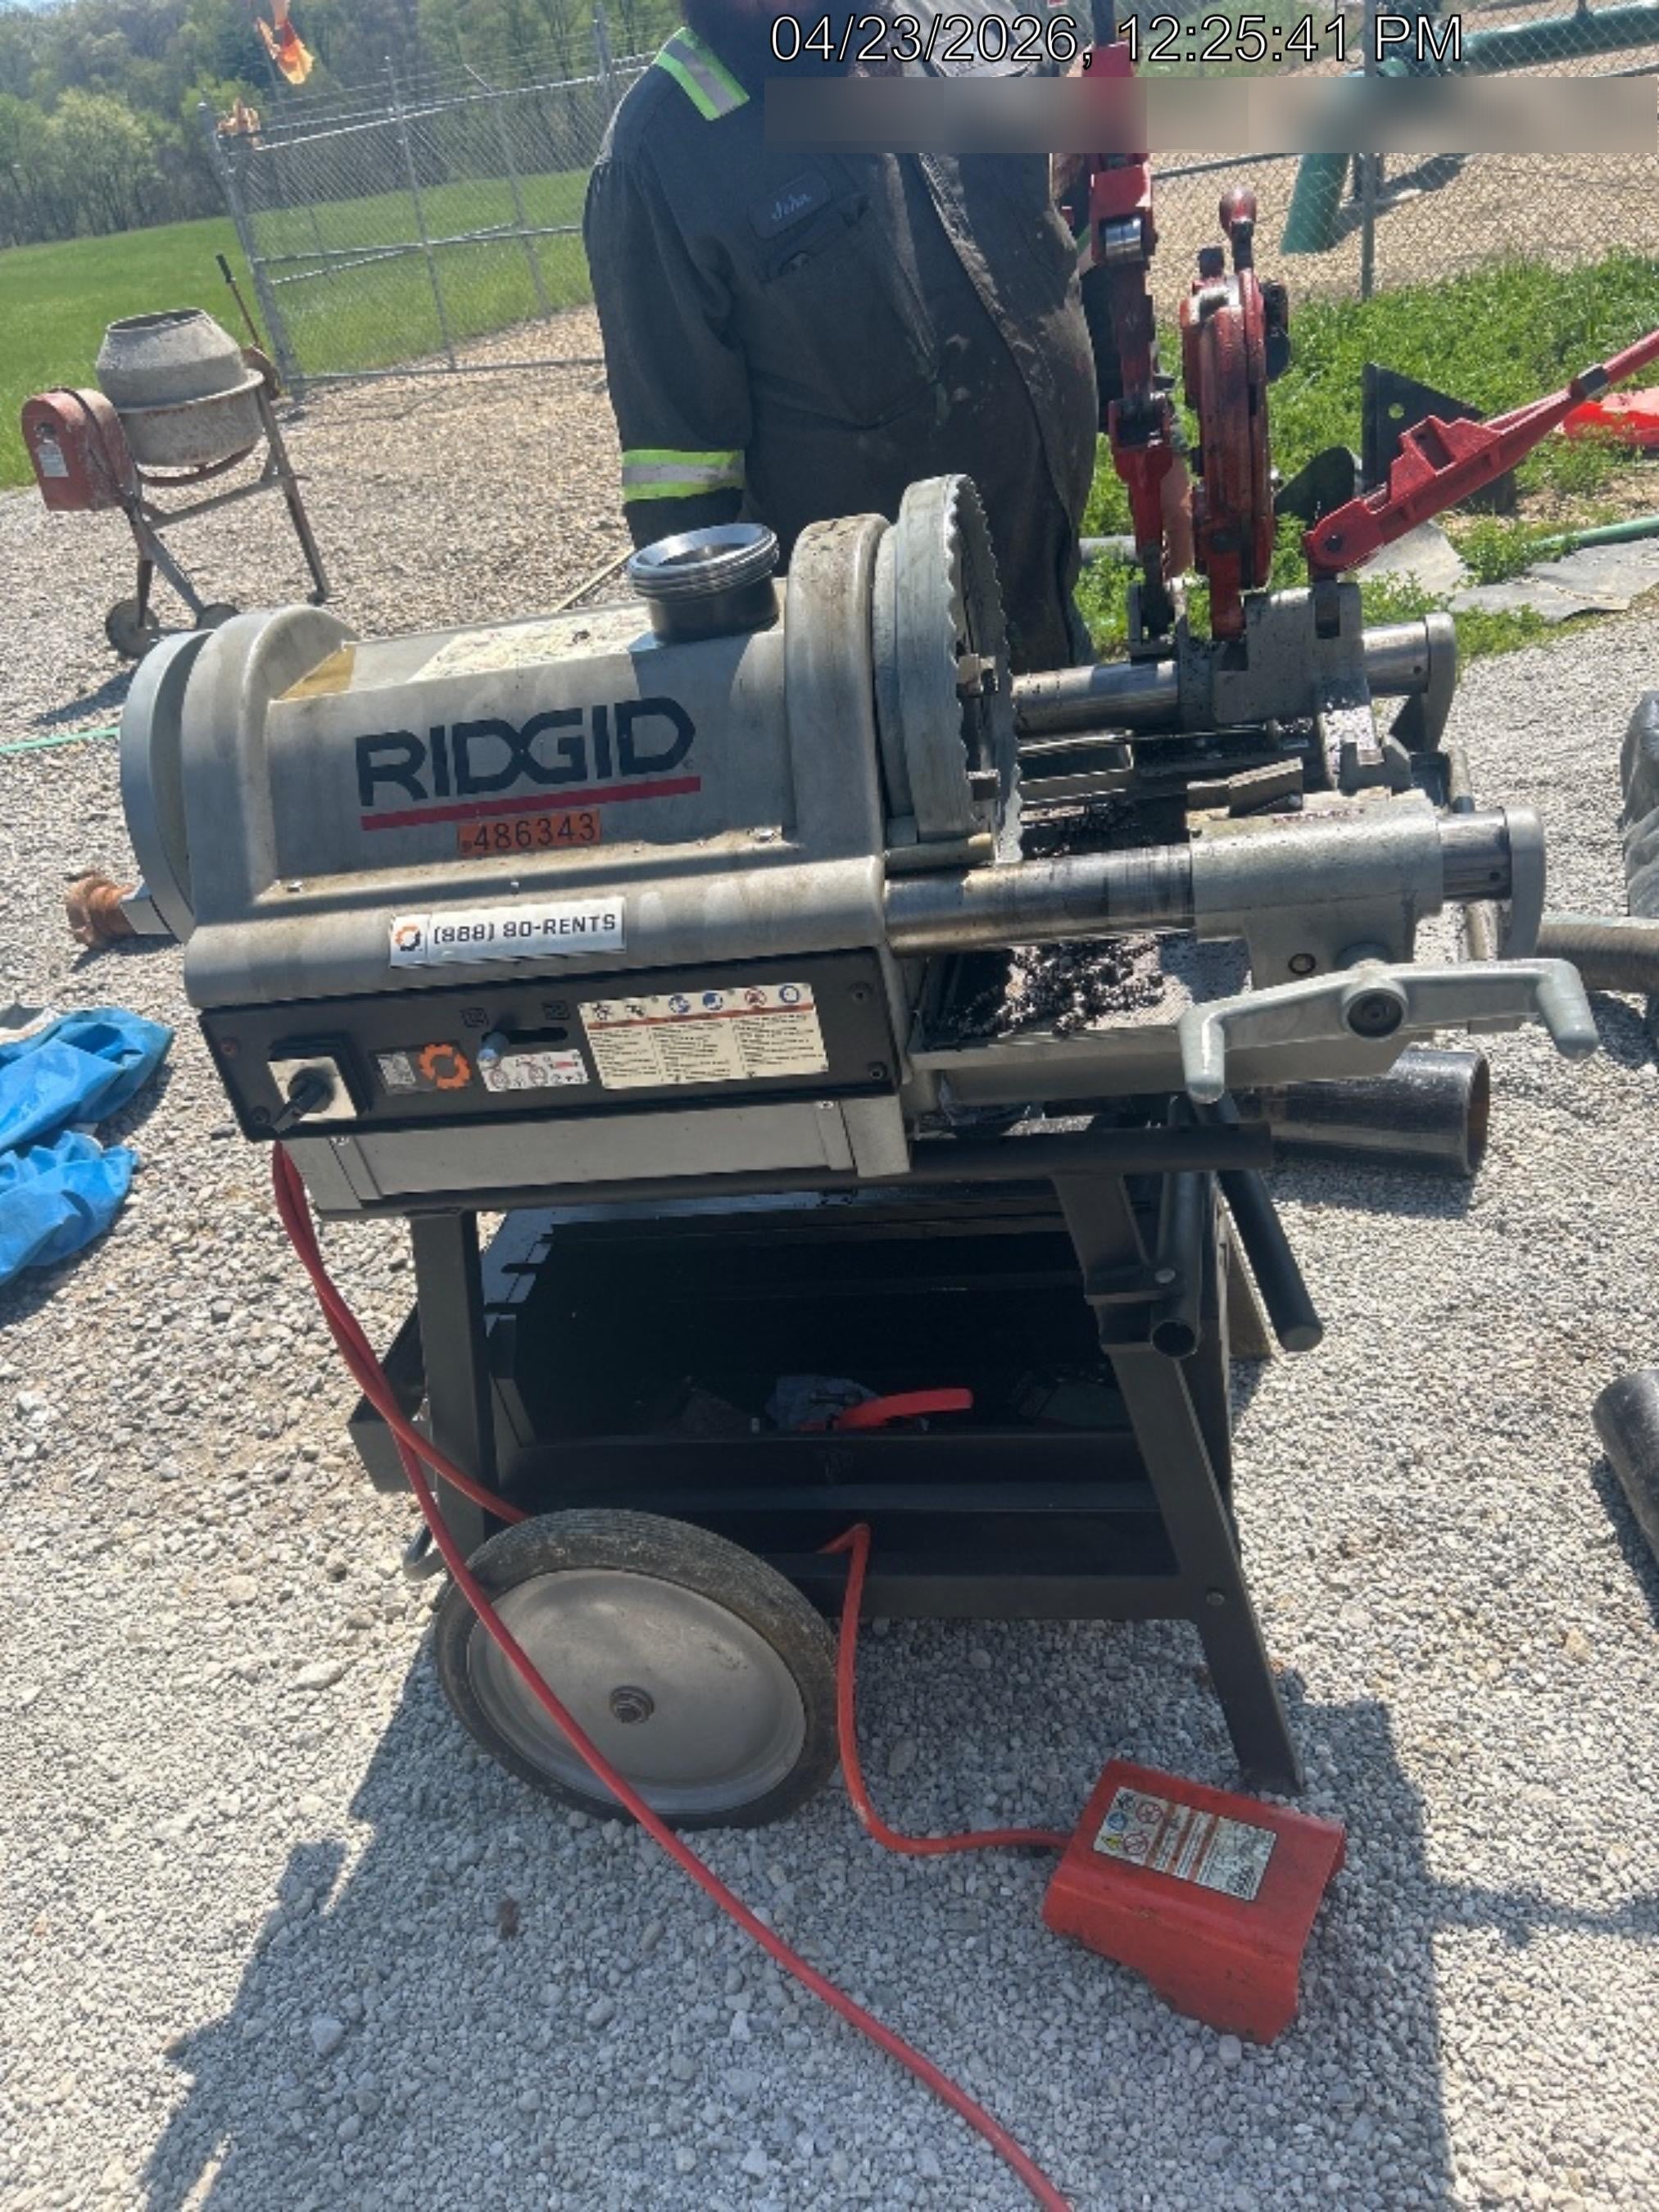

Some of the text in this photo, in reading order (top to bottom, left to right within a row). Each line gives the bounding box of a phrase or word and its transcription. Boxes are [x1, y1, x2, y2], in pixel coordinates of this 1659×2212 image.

[355, 696, 696, 807] RIDGID
[474, 812, 596, 851] 486343
[433, 913, 616, 945] (888) 80-RENTS
